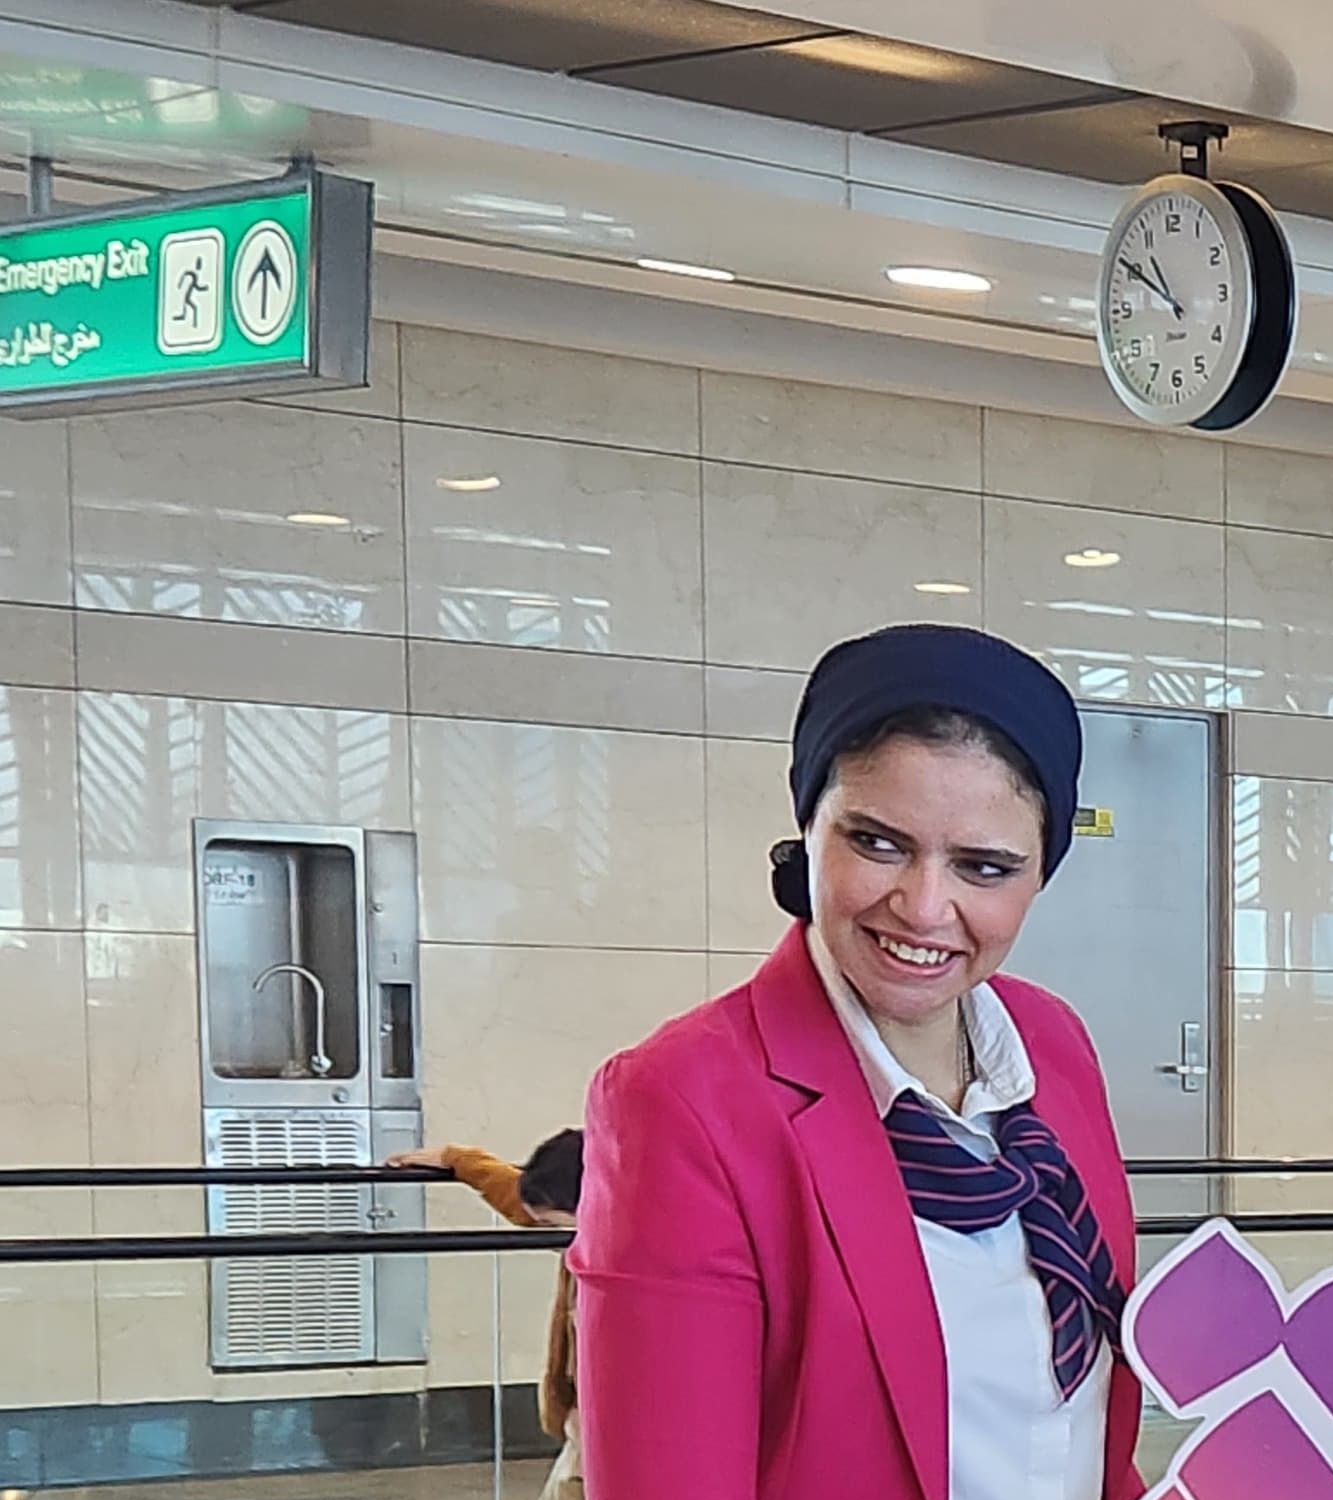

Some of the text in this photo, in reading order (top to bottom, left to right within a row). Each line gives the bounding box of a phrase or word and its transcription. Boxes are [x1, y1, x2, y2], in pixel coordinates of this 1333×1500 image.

[1165, 214, 1181, 233] 12
[1144, 230, 1154, 250] 11
[107, 239, 149, 279] Exit
[1209, 246, 1221, 266] 2
[1217, 284, 1229, 303] 3
[1211, 325, 1223, 344] 4
[1149, 362, 1161, 381] 7
[1193, 355, 1206, 375] 5
[1171, 369, 1184, 388] 6
